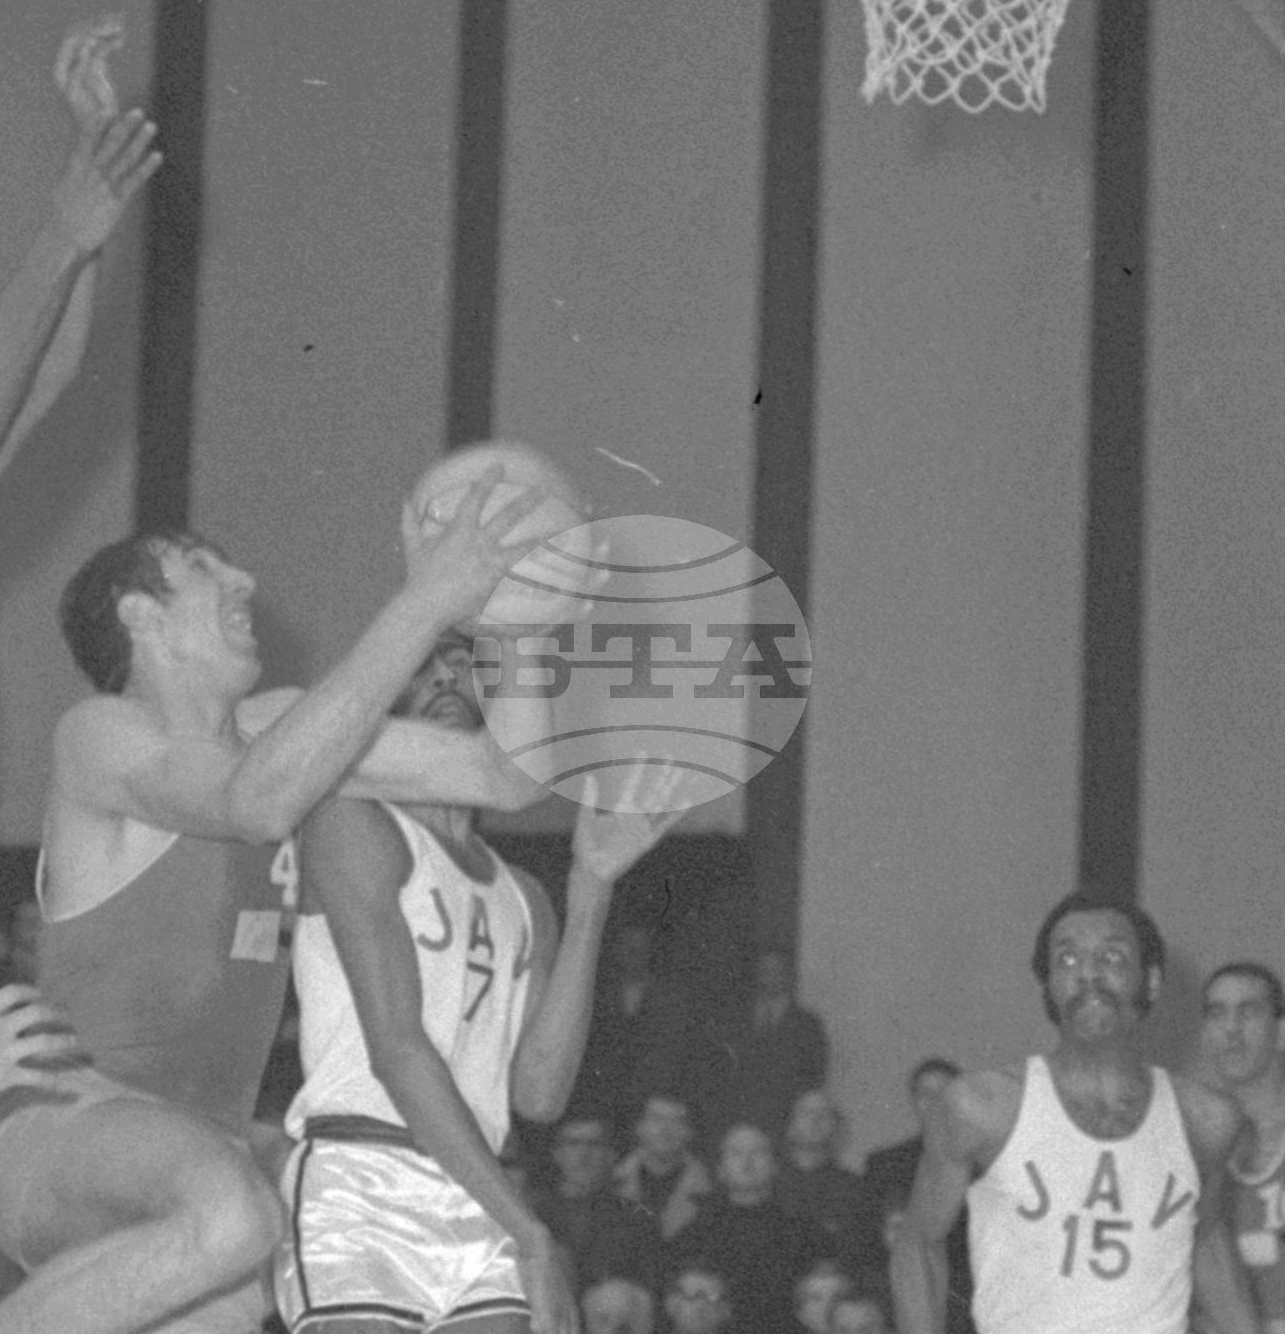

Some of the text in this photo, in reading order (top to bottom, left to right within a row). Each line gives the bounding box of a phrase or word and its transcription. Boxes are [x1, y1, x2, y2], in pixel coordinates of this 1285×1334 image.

[269, 837, 299, 907] 4
[464, 961, 495, 1022] 7
[1017, 1150, 1195, 1230] JAV
[1060, 1214, 1133, 1281] 15
